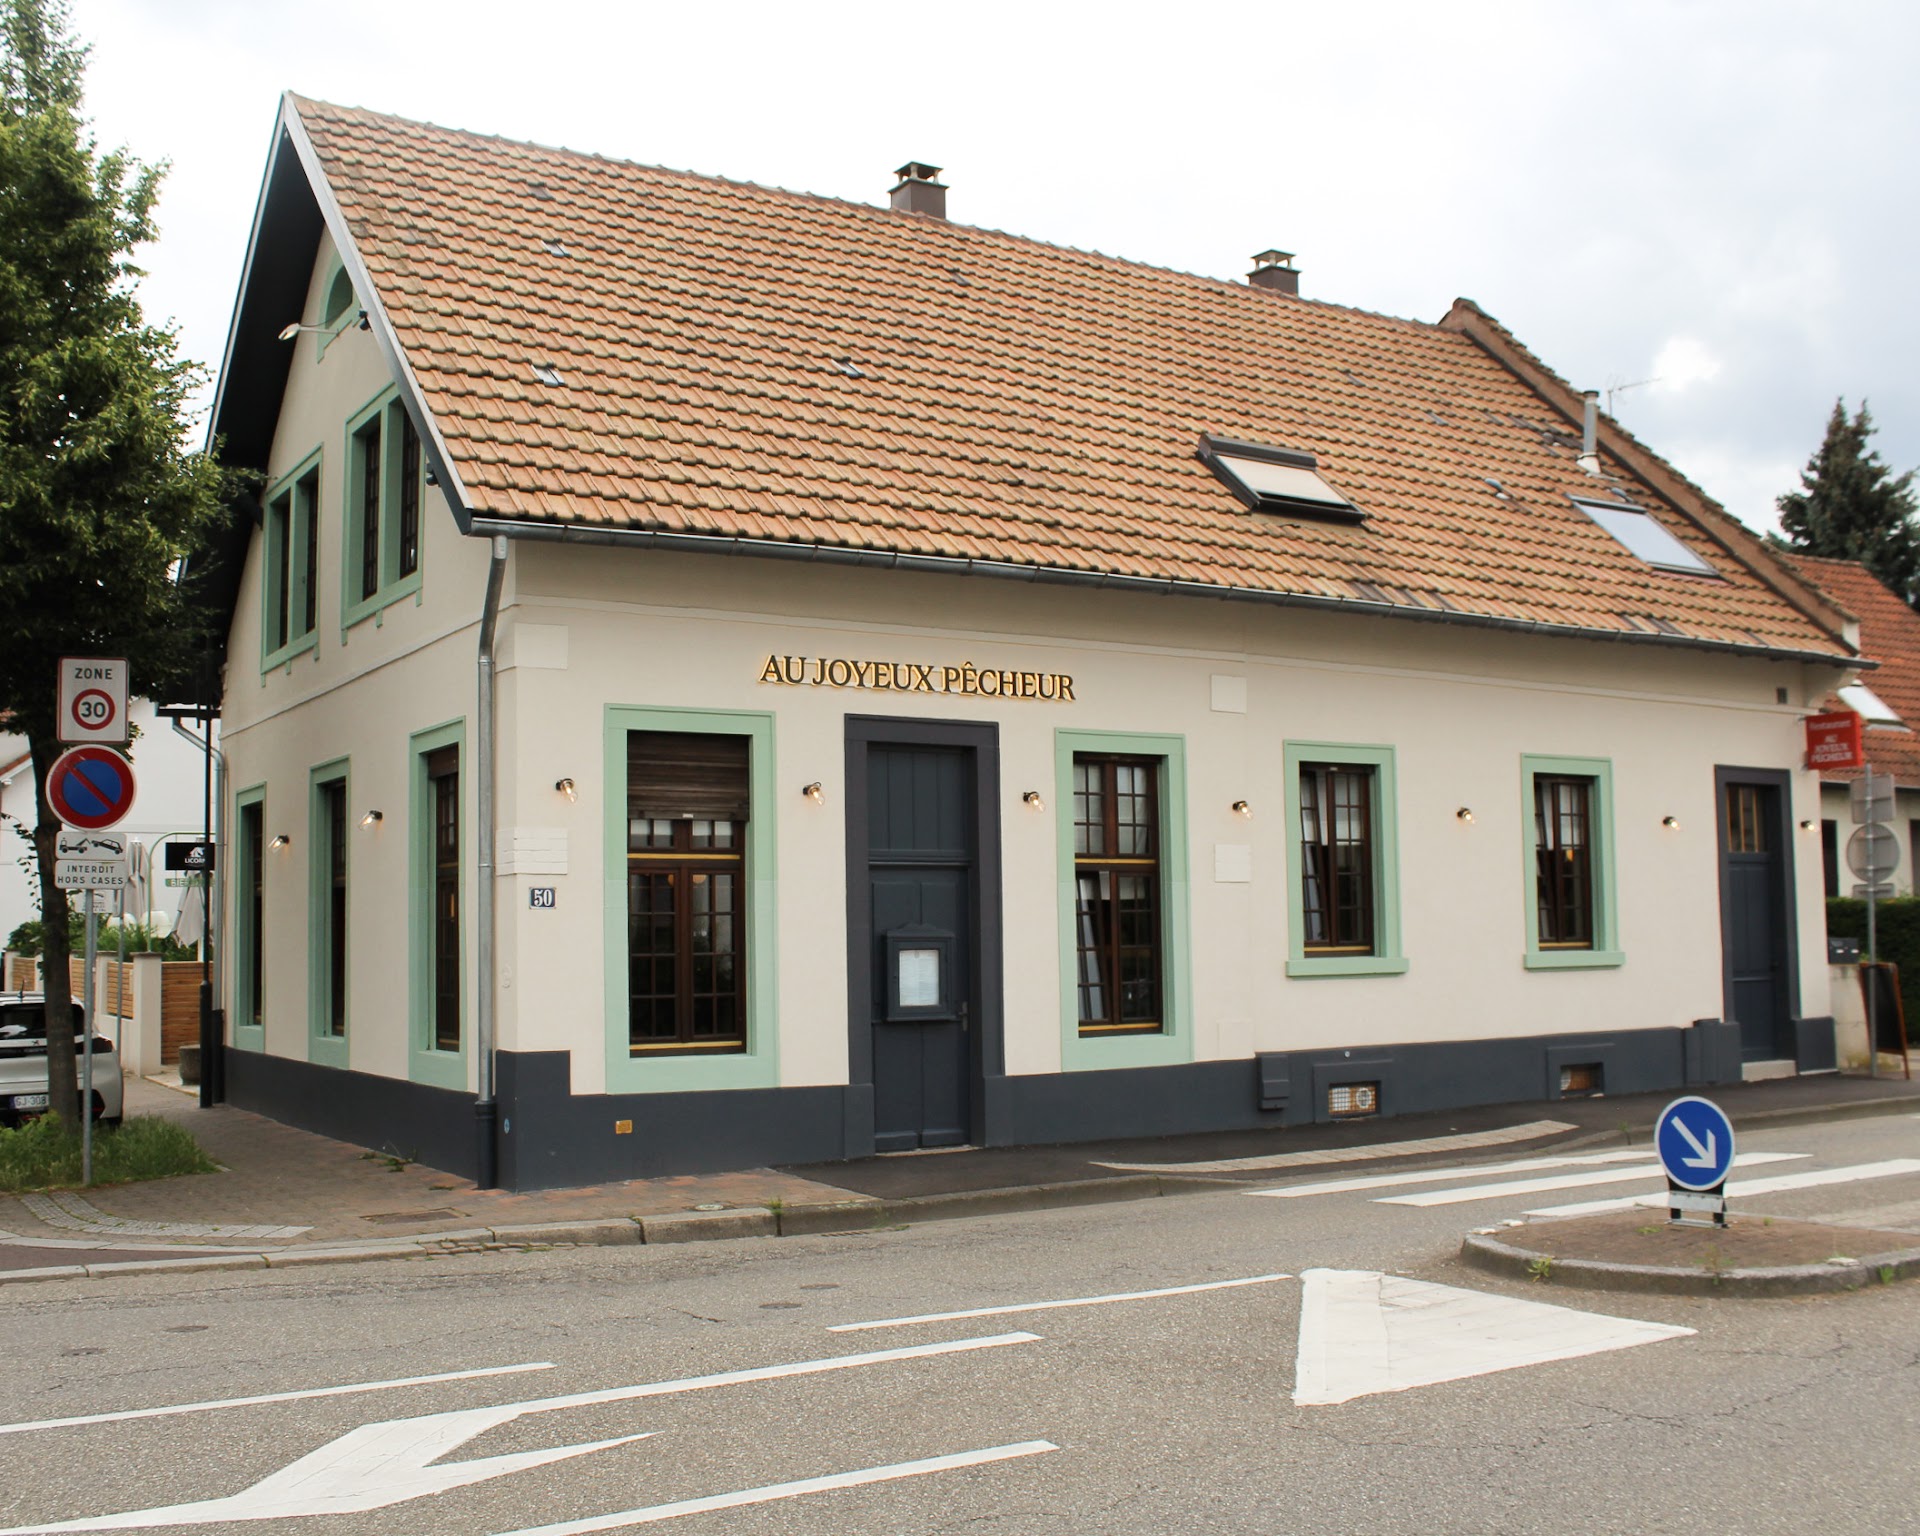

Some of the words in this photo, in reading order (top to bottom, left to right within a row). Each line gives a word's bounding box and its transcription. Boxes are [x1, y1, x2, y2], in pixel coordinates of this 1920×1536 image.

[75, 668, 112, 679] ZONE
[758, 654, 807, 685] AU
[811, 657, 935, 691] JOYEUX
[941, 660, 1076, 701] PÊCHEUR
[81, 701, 106, 718] 30
[67, 865, 115, 873] INTERDIT
[57, 876, 86, 884] HORS
[91, 877, 124, 885] CASES
[533, 889, 553, 907] 50
